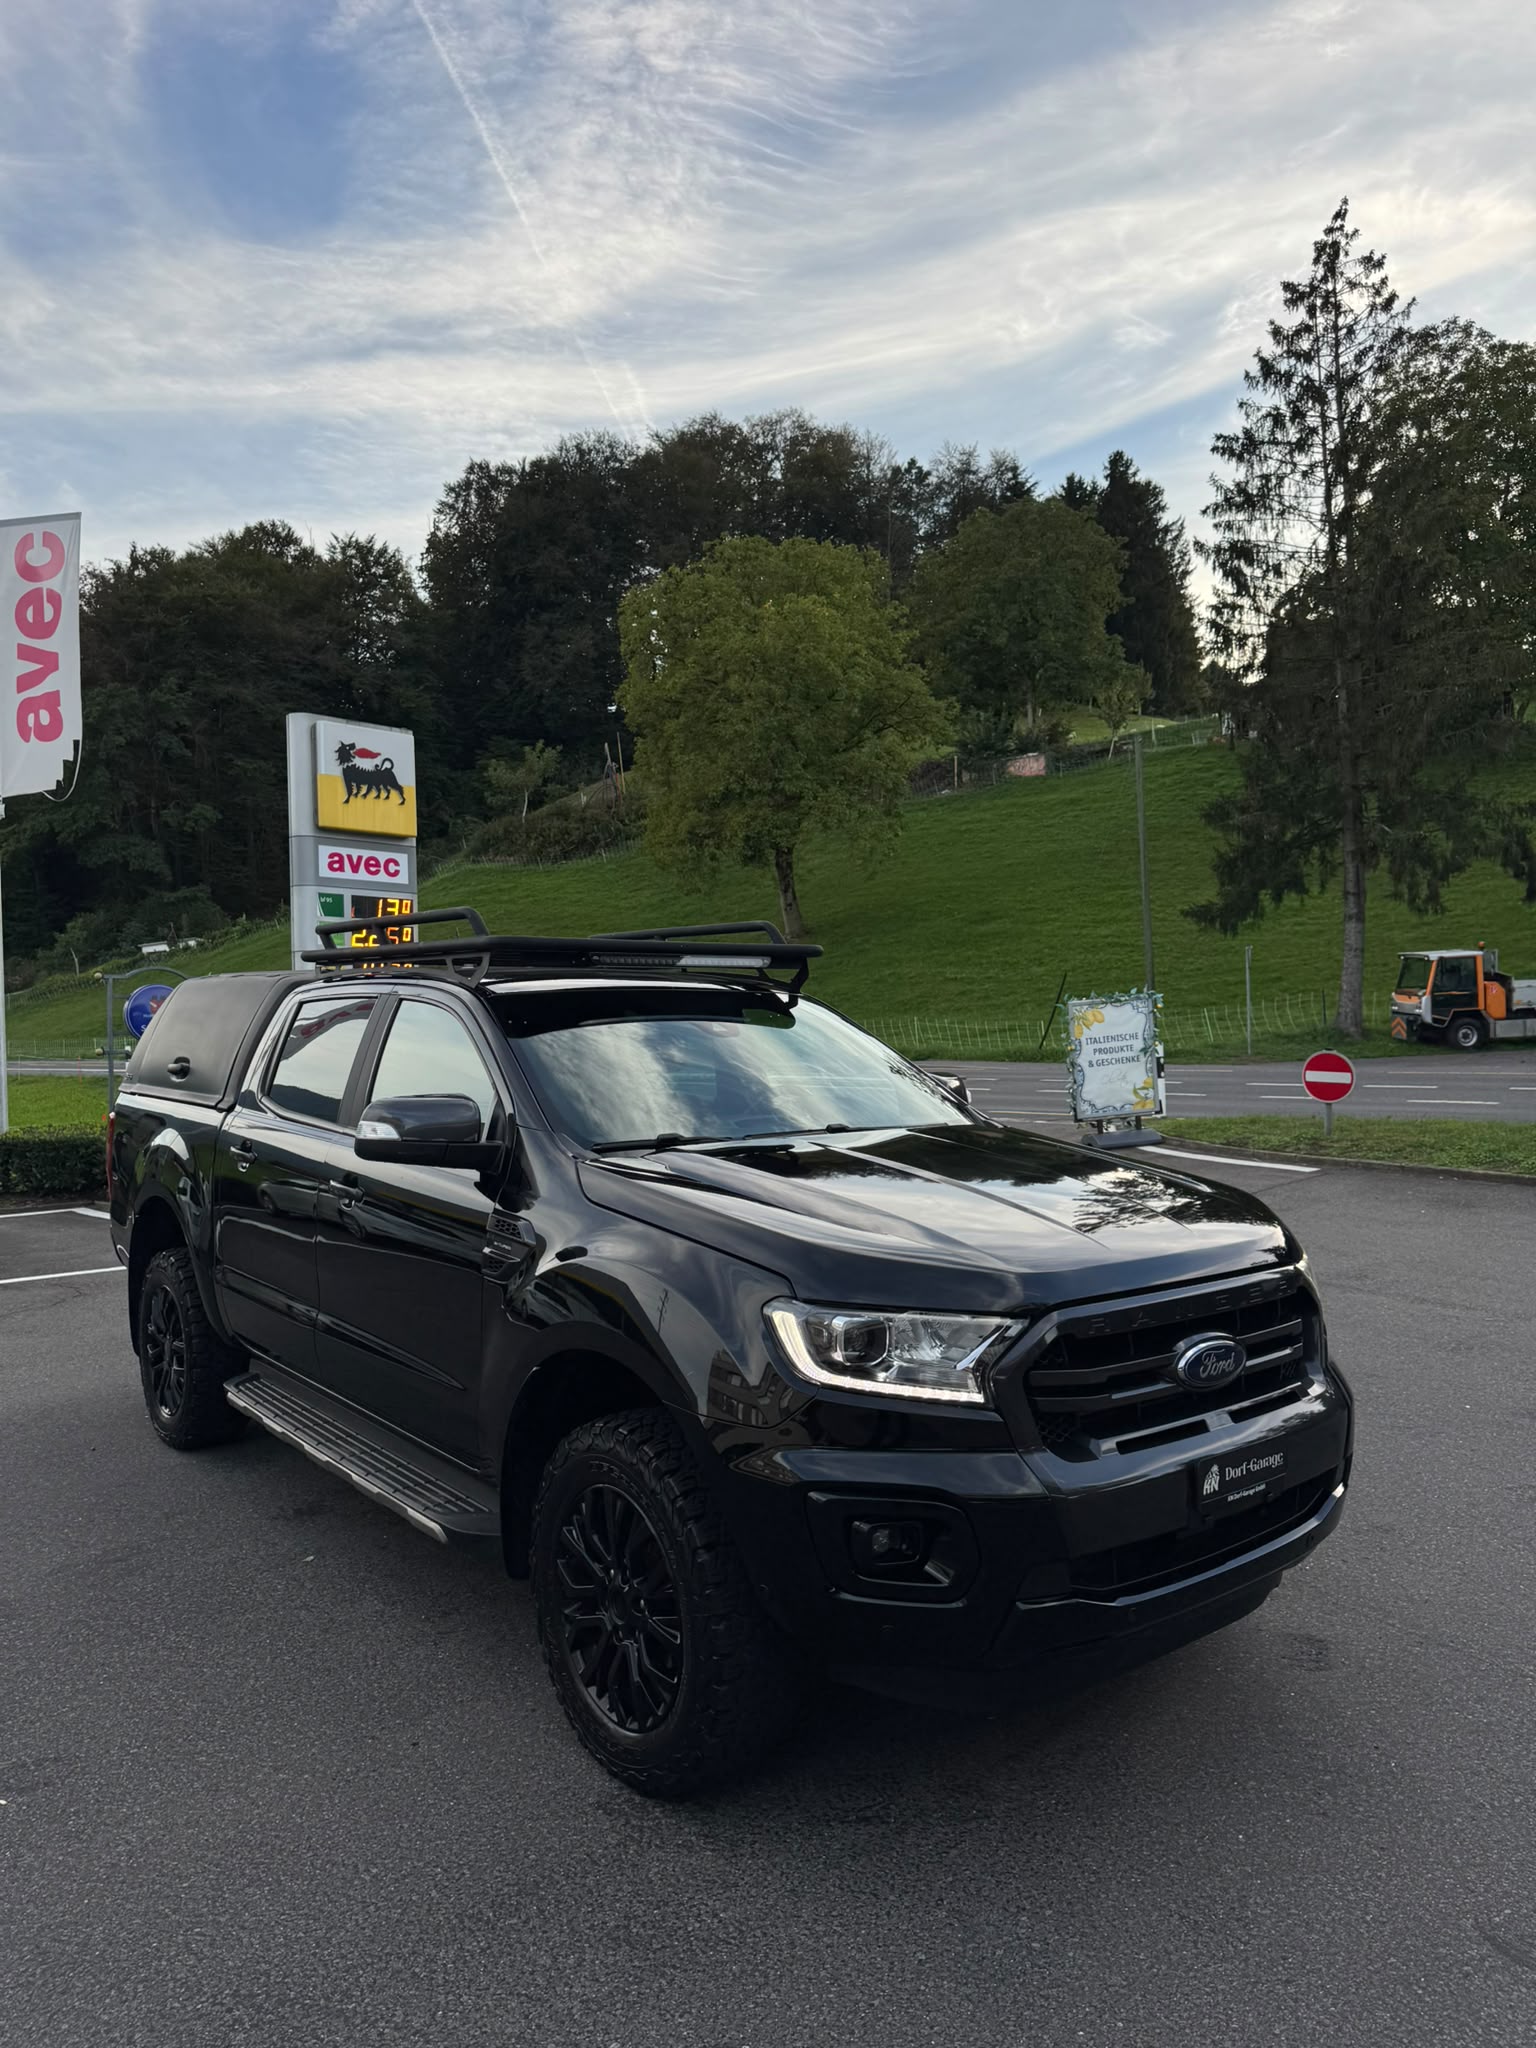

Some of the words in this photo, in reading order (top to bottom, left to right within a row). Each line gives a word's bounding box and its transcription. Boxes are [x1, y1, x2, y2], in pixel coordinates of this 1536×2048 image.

[14, 530, 65, 743] avec
[327, 852, 401, 878] avec
[1085, 1032, 1139, 1045] ITALIENISCHE
[1093, 1044, 1134, 1056] PRODUKTE
[1088, 1060, 1094, 1068] &
[1096, 1055, 1141, 1067] GESCHENKE
[1199, 1349, 1235, 1378] Ford
[1225, 1452, 1284, 1481] Dorf-Garage
